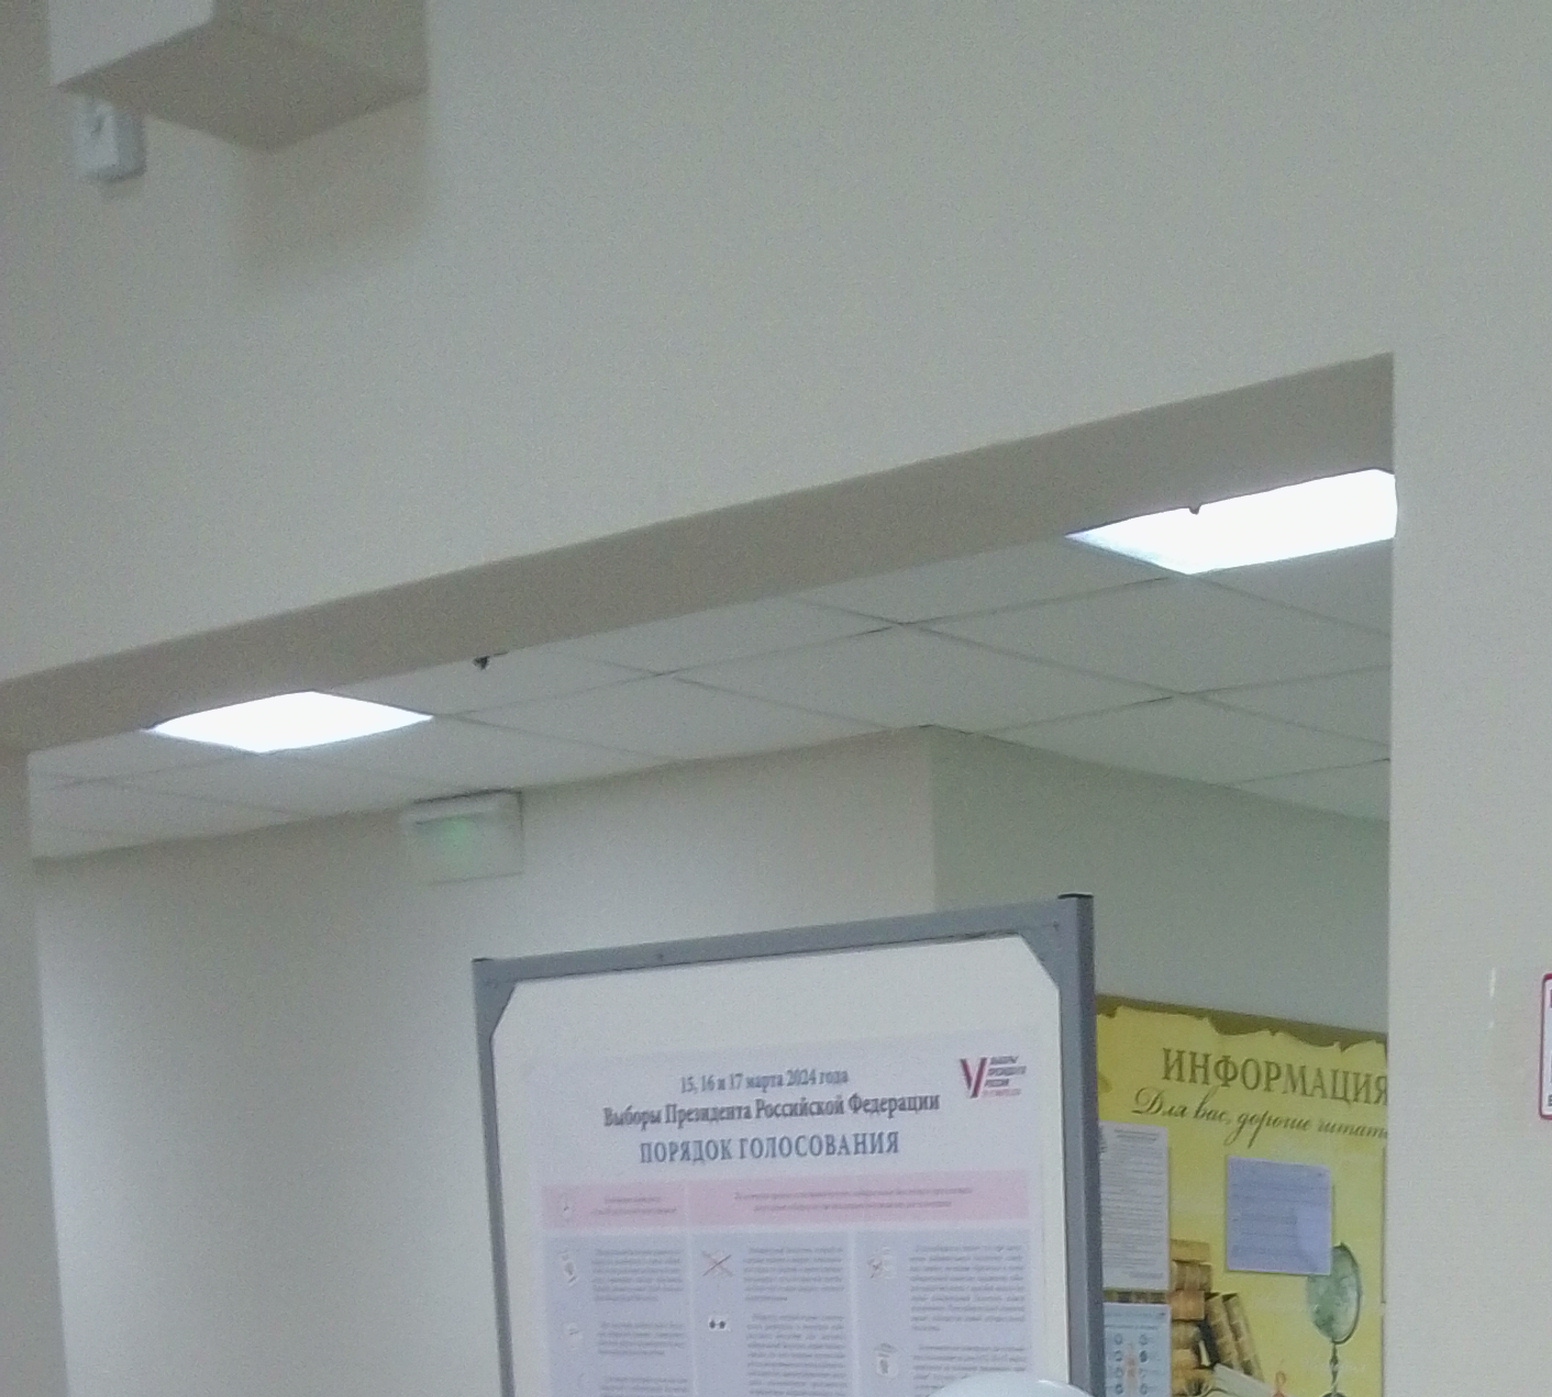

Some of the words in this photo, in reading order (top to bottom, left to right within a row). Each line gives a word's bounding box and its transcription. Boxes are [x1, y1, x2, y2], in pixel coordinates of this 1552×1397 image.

[681, 1076, 698, 1094] 15,
[702, 1074, 715, 1091] 16
[717, 1078, 726, 1090] и
[730, 1072, 743, 1090] 17
[746, 1073, 783, 1093] марта
[787, 1069, 817, 1087] 2024
[820, 1070, 849, 1085] года
[1161, 1047, 1387, 1106] ИНФОРМАЦИЯ
[603, 1105, 662, 1131] Выборы
[665, 1103, 752, 1129] Президента
[755, 1097, 845, 1119] Российской
[848, 1094, 941, 1119] Федерации
[1131, 1087, 1187, 1118] Для
[640, 1138, 732, 1165] ПОРЯДОК
[740, 1131, 900, 1160] ГОЛОСОВАНИЯ
